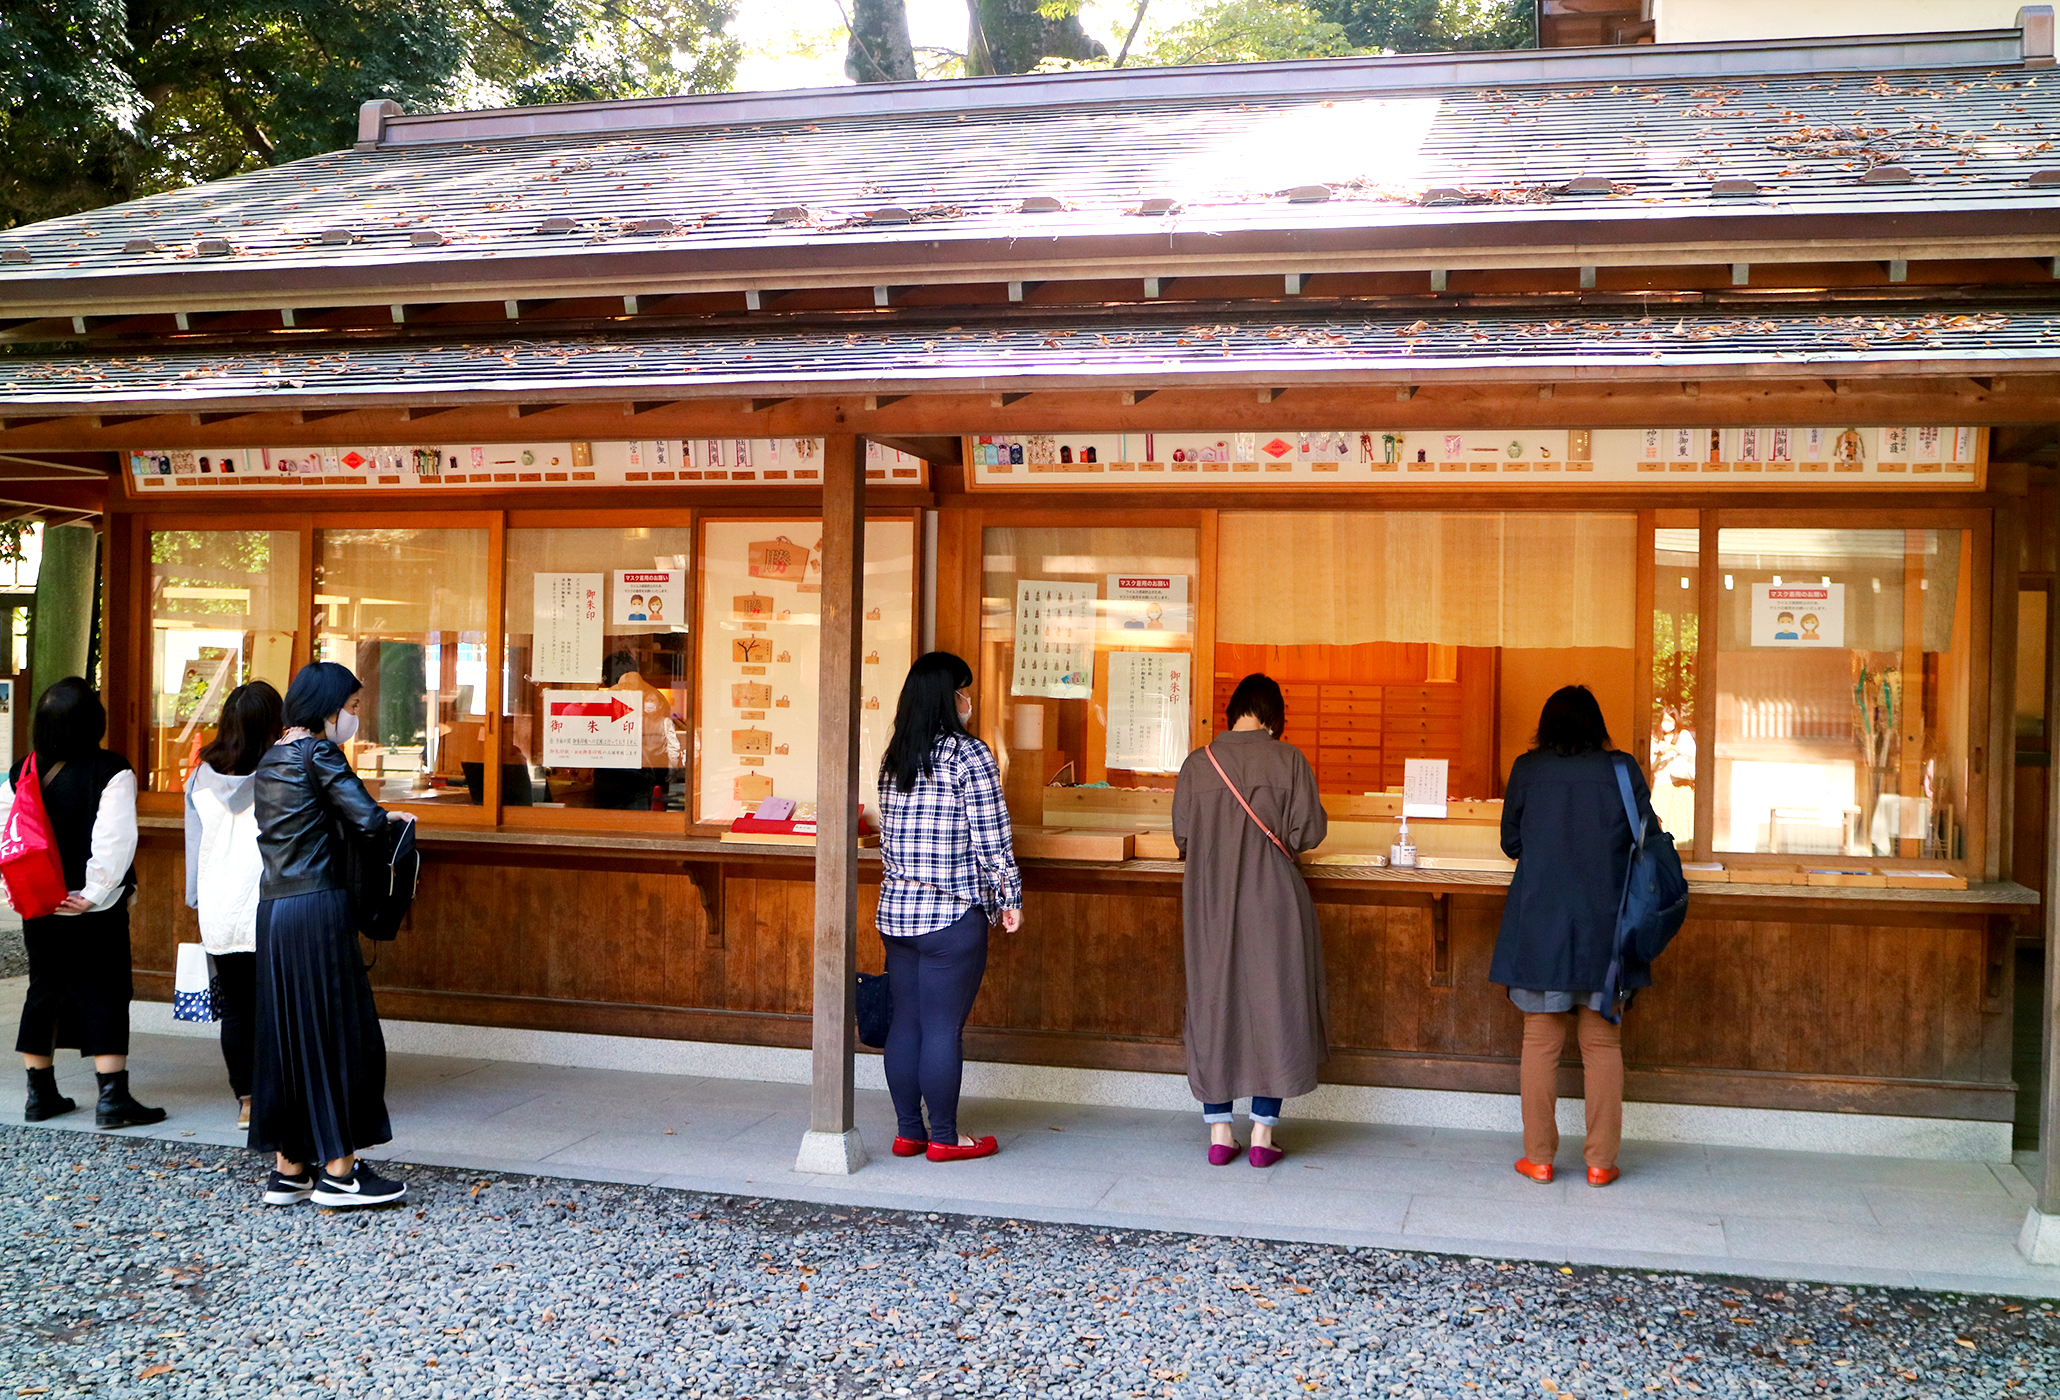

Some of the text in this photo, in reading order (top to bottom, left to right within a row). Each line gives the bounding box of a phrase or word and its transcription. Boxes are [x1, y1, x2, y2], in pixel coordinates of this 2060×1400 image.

[763, 548, 792, 574] 勝
[586, 589, 596, 622] 御朱印
[744, 599, 762, 616] 勝
[1170, 670, 1181, 704] 御朱印
